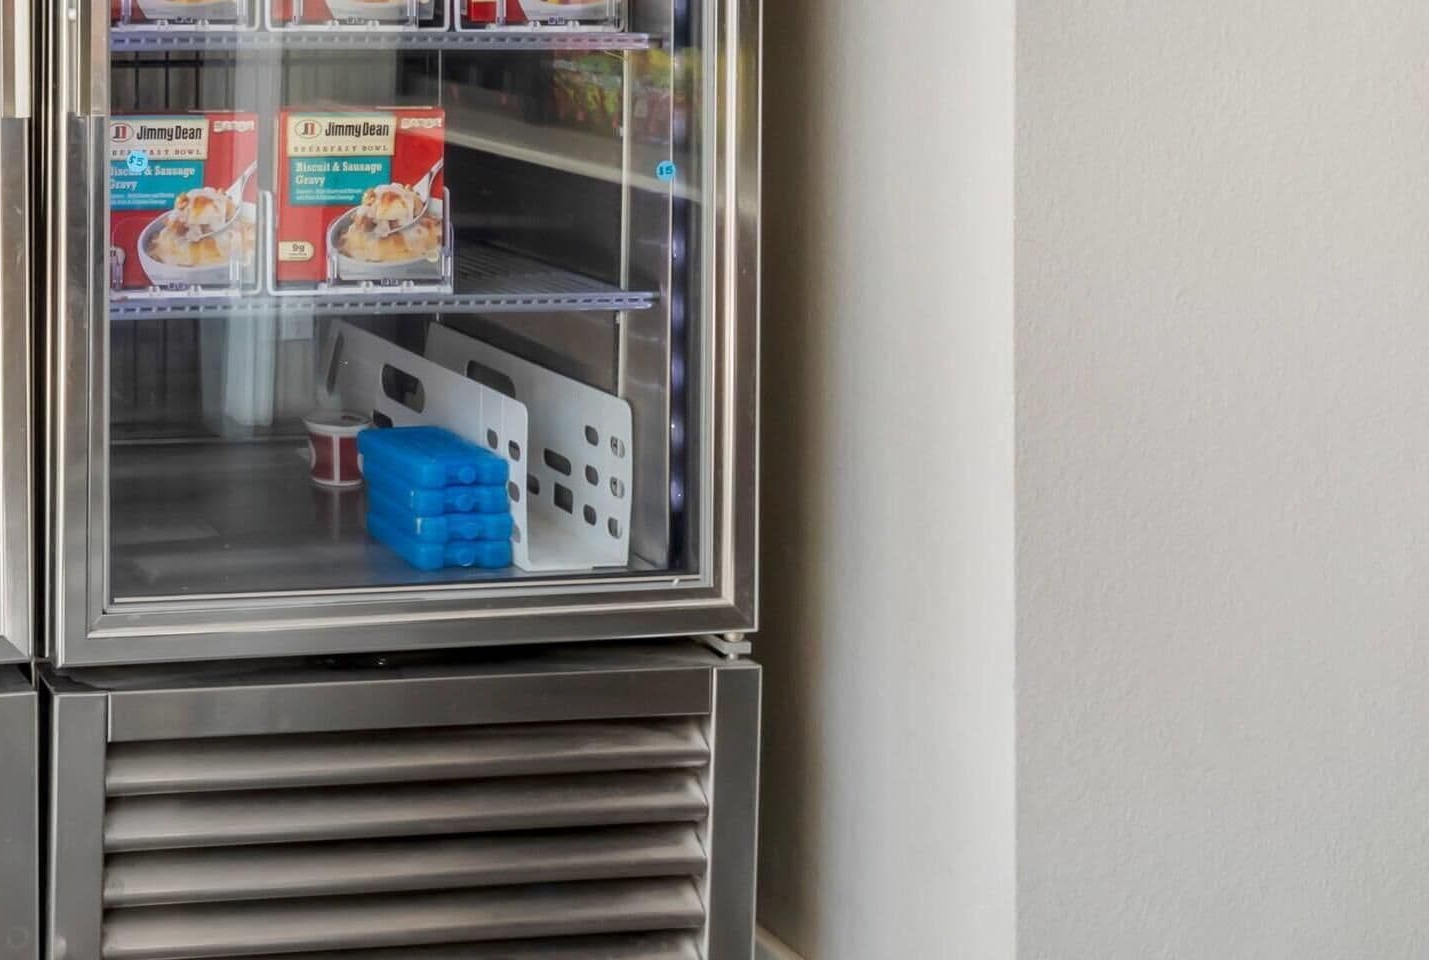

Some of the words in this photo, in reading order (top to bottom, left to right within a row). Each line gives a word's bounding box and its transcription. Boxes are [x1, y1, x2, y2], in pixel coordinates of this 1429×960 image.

[136, 125, 173, 141] Jimmy
[175, 126, 202, 140] Dean
[325, 122, 361, 138] Jimmy
[363, 123, 389, 137] Dean
[129, 156, 144, 167] $5
[144, 166, 152, 176] &
[154, 166, 195, 178] Sausage
[296, 162, 331, 172] Biscuit
[332, 162, 340, 172] &
[342, 162, 383, 174] Sausage
[659, 167, 673, 176] $5
[295, 175, 326, 187] Gravy
